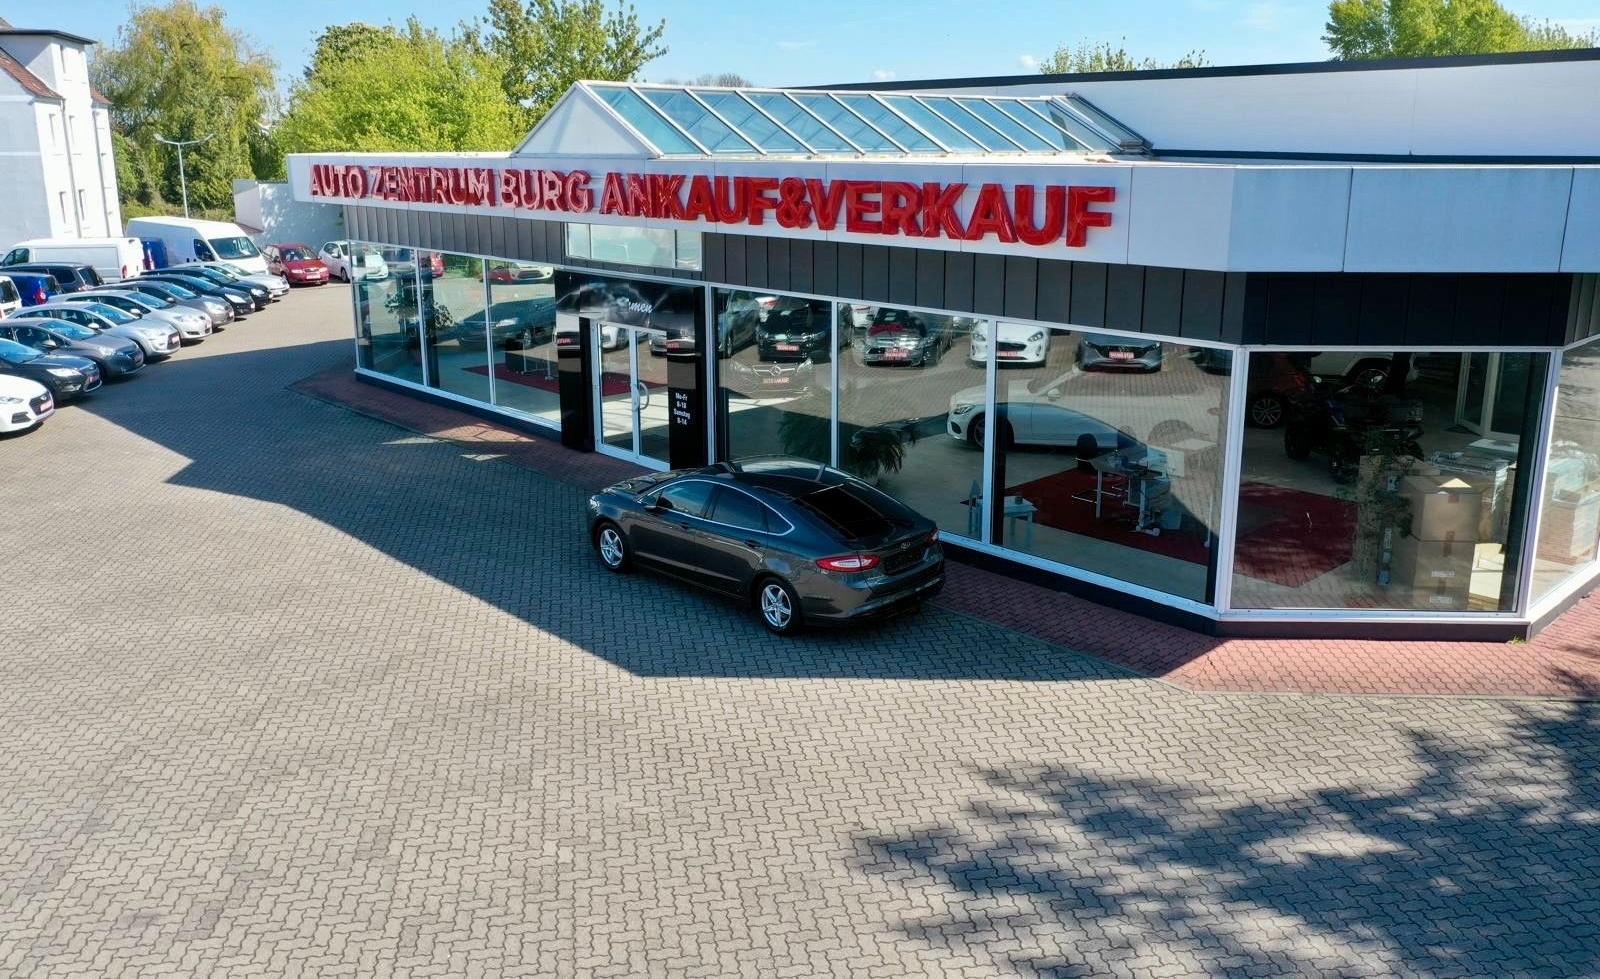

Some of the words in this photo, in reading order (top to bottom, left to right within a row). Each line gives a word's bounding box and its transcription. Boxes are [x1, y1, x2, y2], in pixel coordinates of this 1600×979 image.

[310, 164, 366, 198] AUTO
[368, 166, 496, 206] ZENTRUM
[499, 168, 592, 213] BURG
[673, 408, 690, 420] Samstag
